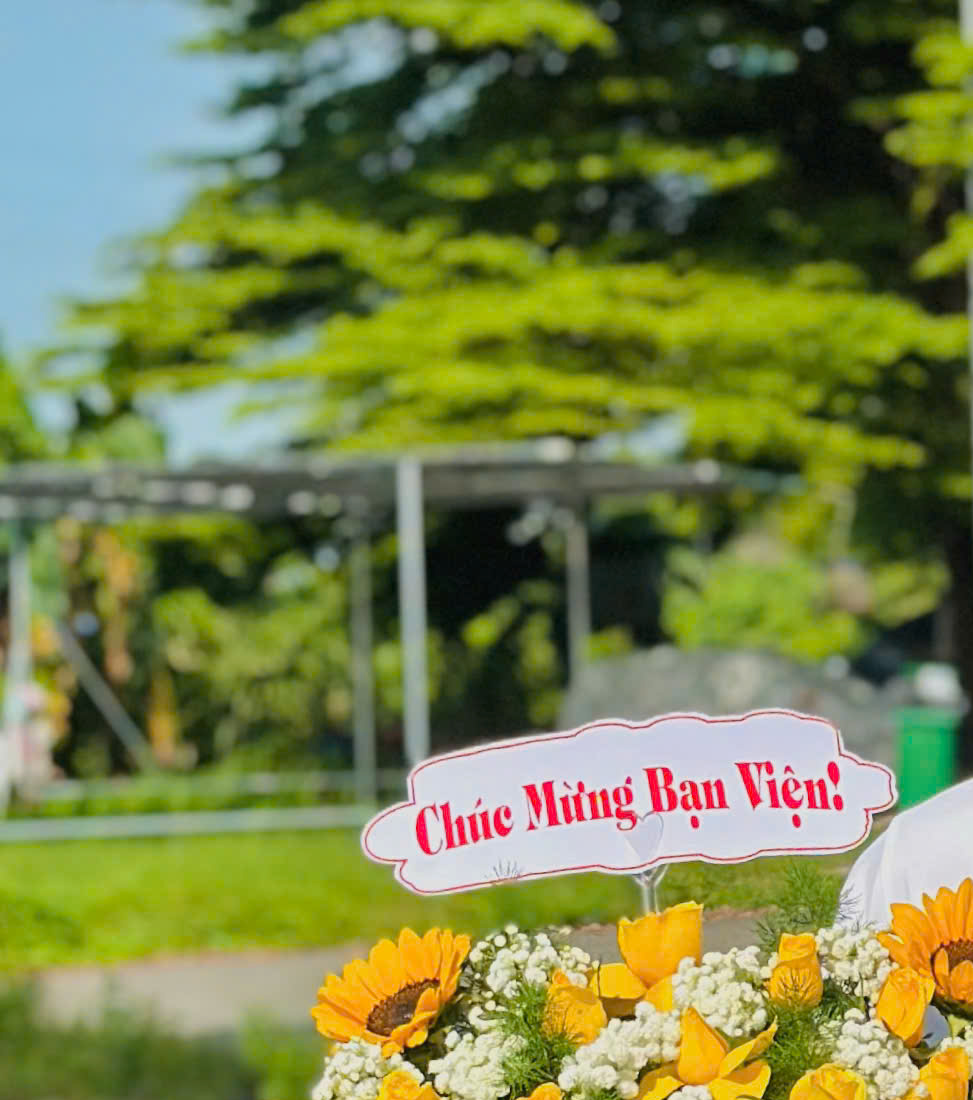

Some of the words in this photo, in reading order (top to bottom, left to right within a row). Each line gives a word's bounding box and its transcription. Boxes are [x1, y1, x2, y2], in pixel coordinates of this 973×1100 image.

[415, 798, 514, 856] Chúc
[522, 776, 638, 832] Mừng
[642, 766, 727, 829] Bạn
[734, 760, 844, 829] Viện!
